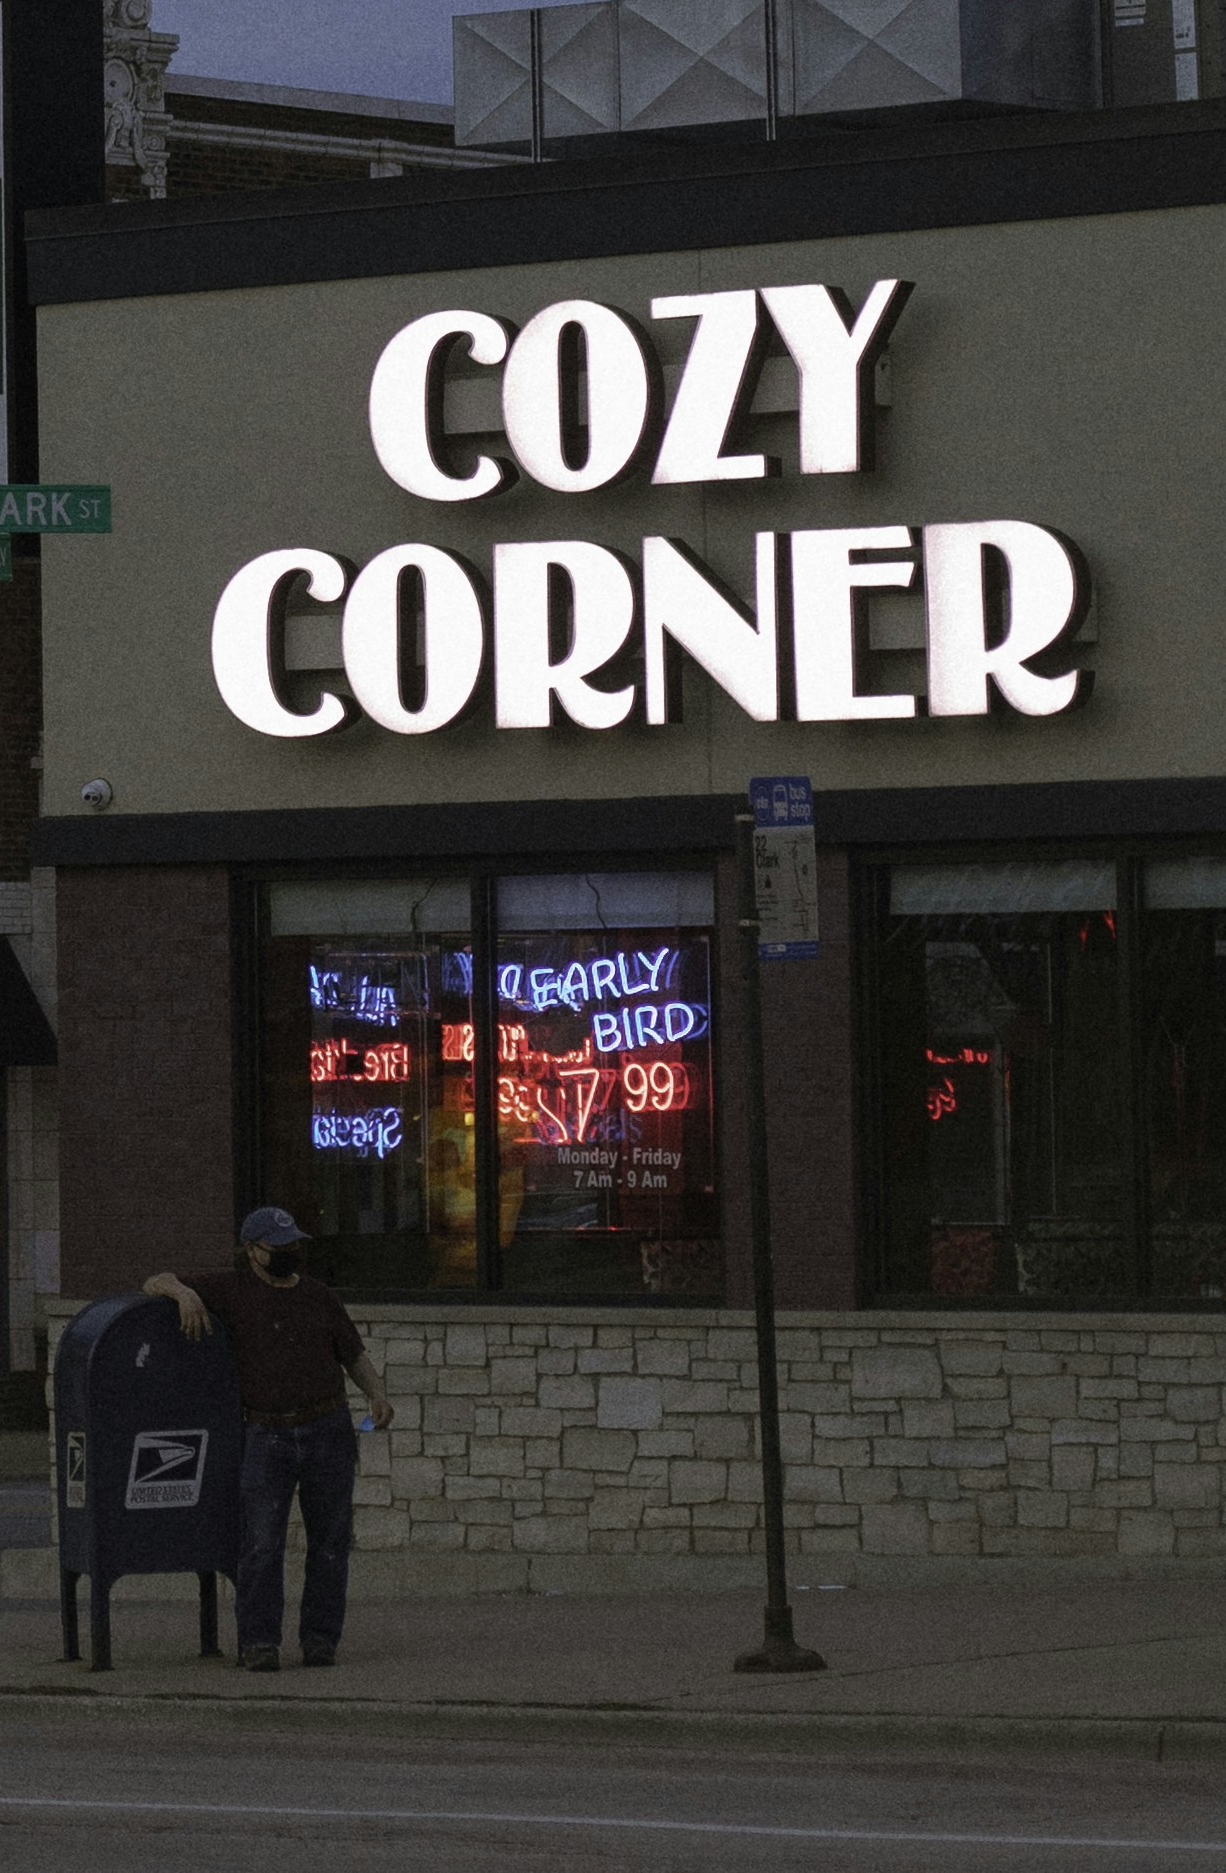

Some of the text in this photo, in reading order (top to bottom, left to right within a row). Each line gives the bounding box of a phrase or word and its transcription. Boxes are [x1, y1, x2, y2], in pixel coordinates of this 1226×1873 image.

[368, 278, 914, 503] COZY
[78, 499, 101, 519] ST
[210, 519, 1095, 738] CORNER
[788, 783, 807, 800] bus
[790, 801, 811, 822] stop
[755, 834, 767, 852] 22
[755, 851, 780, 869] Clark
[530, 947, 669, 1011] EARLY
[593, 1002, 695, 1053] BIRD
[623, 1062, 675, 1112] 99
[557, 1147, 618, 1169] Monday
[632, 1147, 681, 1170] Friday
[574, 1170, 584, 1188] 7
[587, 1170, 613, 1187] Am
[627, 1170, 637, 1188] 9
[641, 1170, 668, 1188] Am
